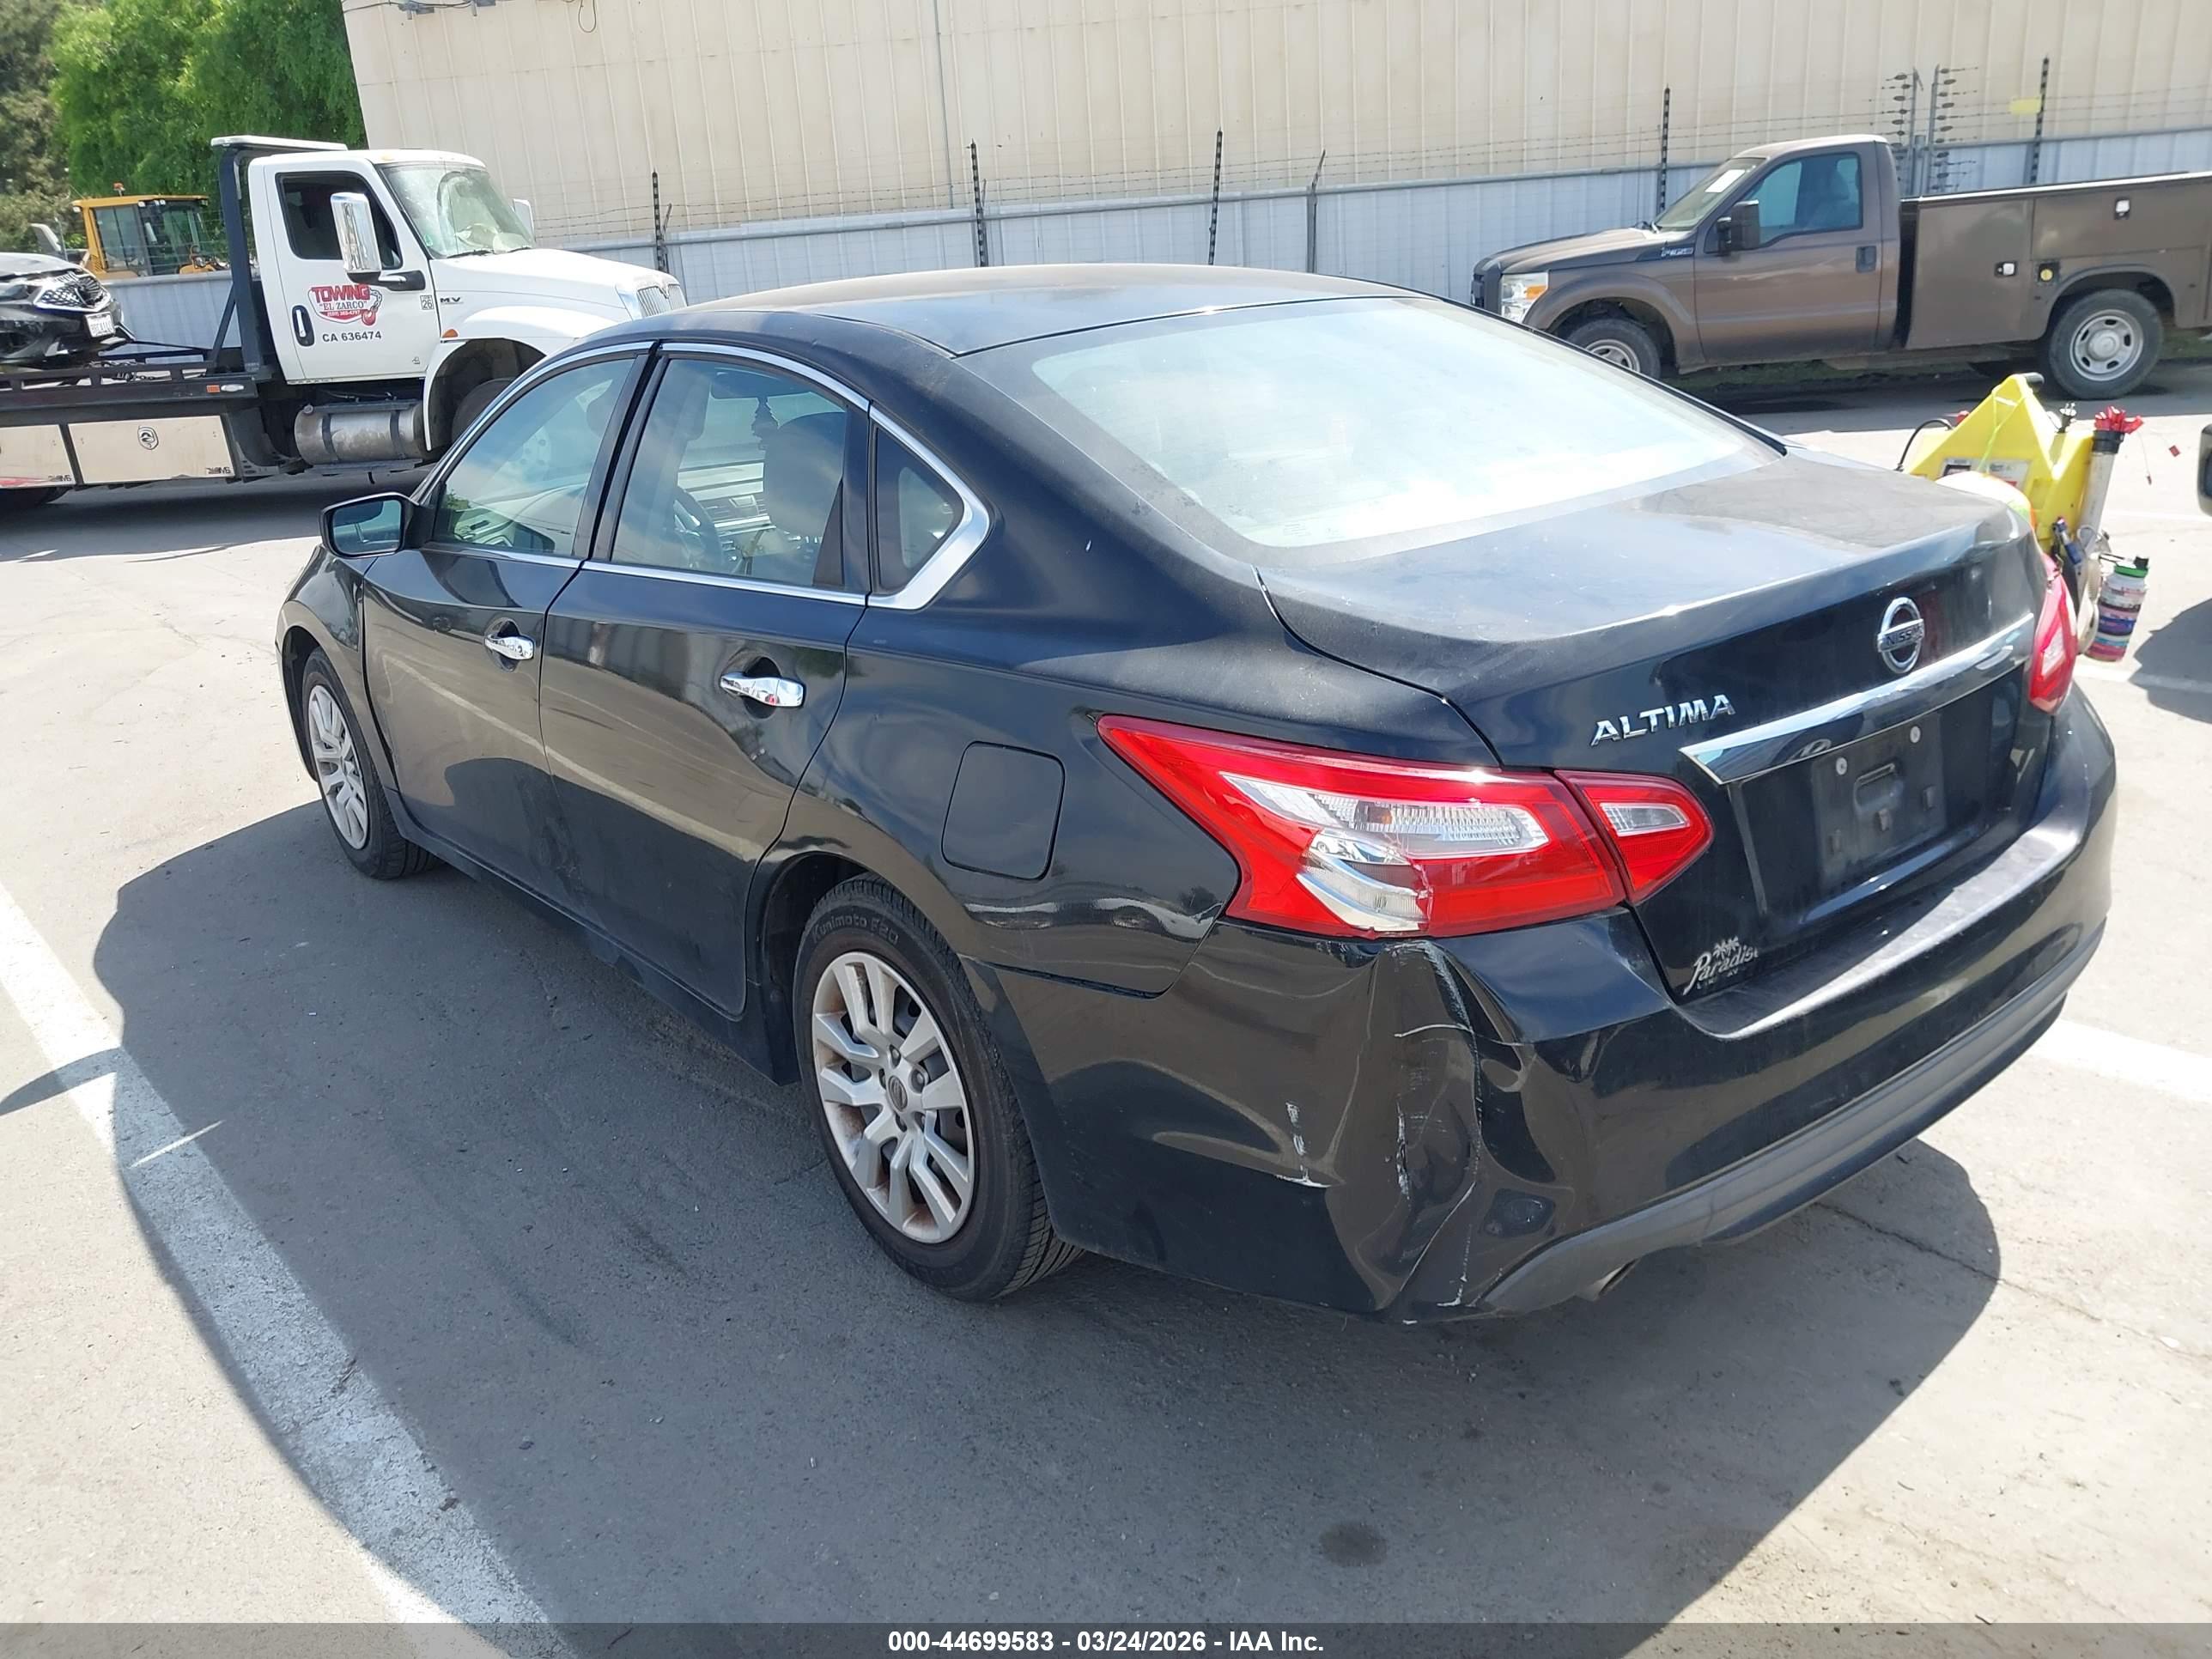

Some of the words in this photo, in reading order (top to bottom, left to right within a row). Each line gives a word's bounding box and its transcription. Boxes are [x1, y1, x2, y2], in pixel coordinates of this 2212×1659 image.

[312, 284, 370, 303] TOWING
[422, 300, 433, 309] 26
[322, 333, 338, 342] CA
[341, 331, 382, 341] 636474
[1590, 694, 1735, 746] ALTIMA
